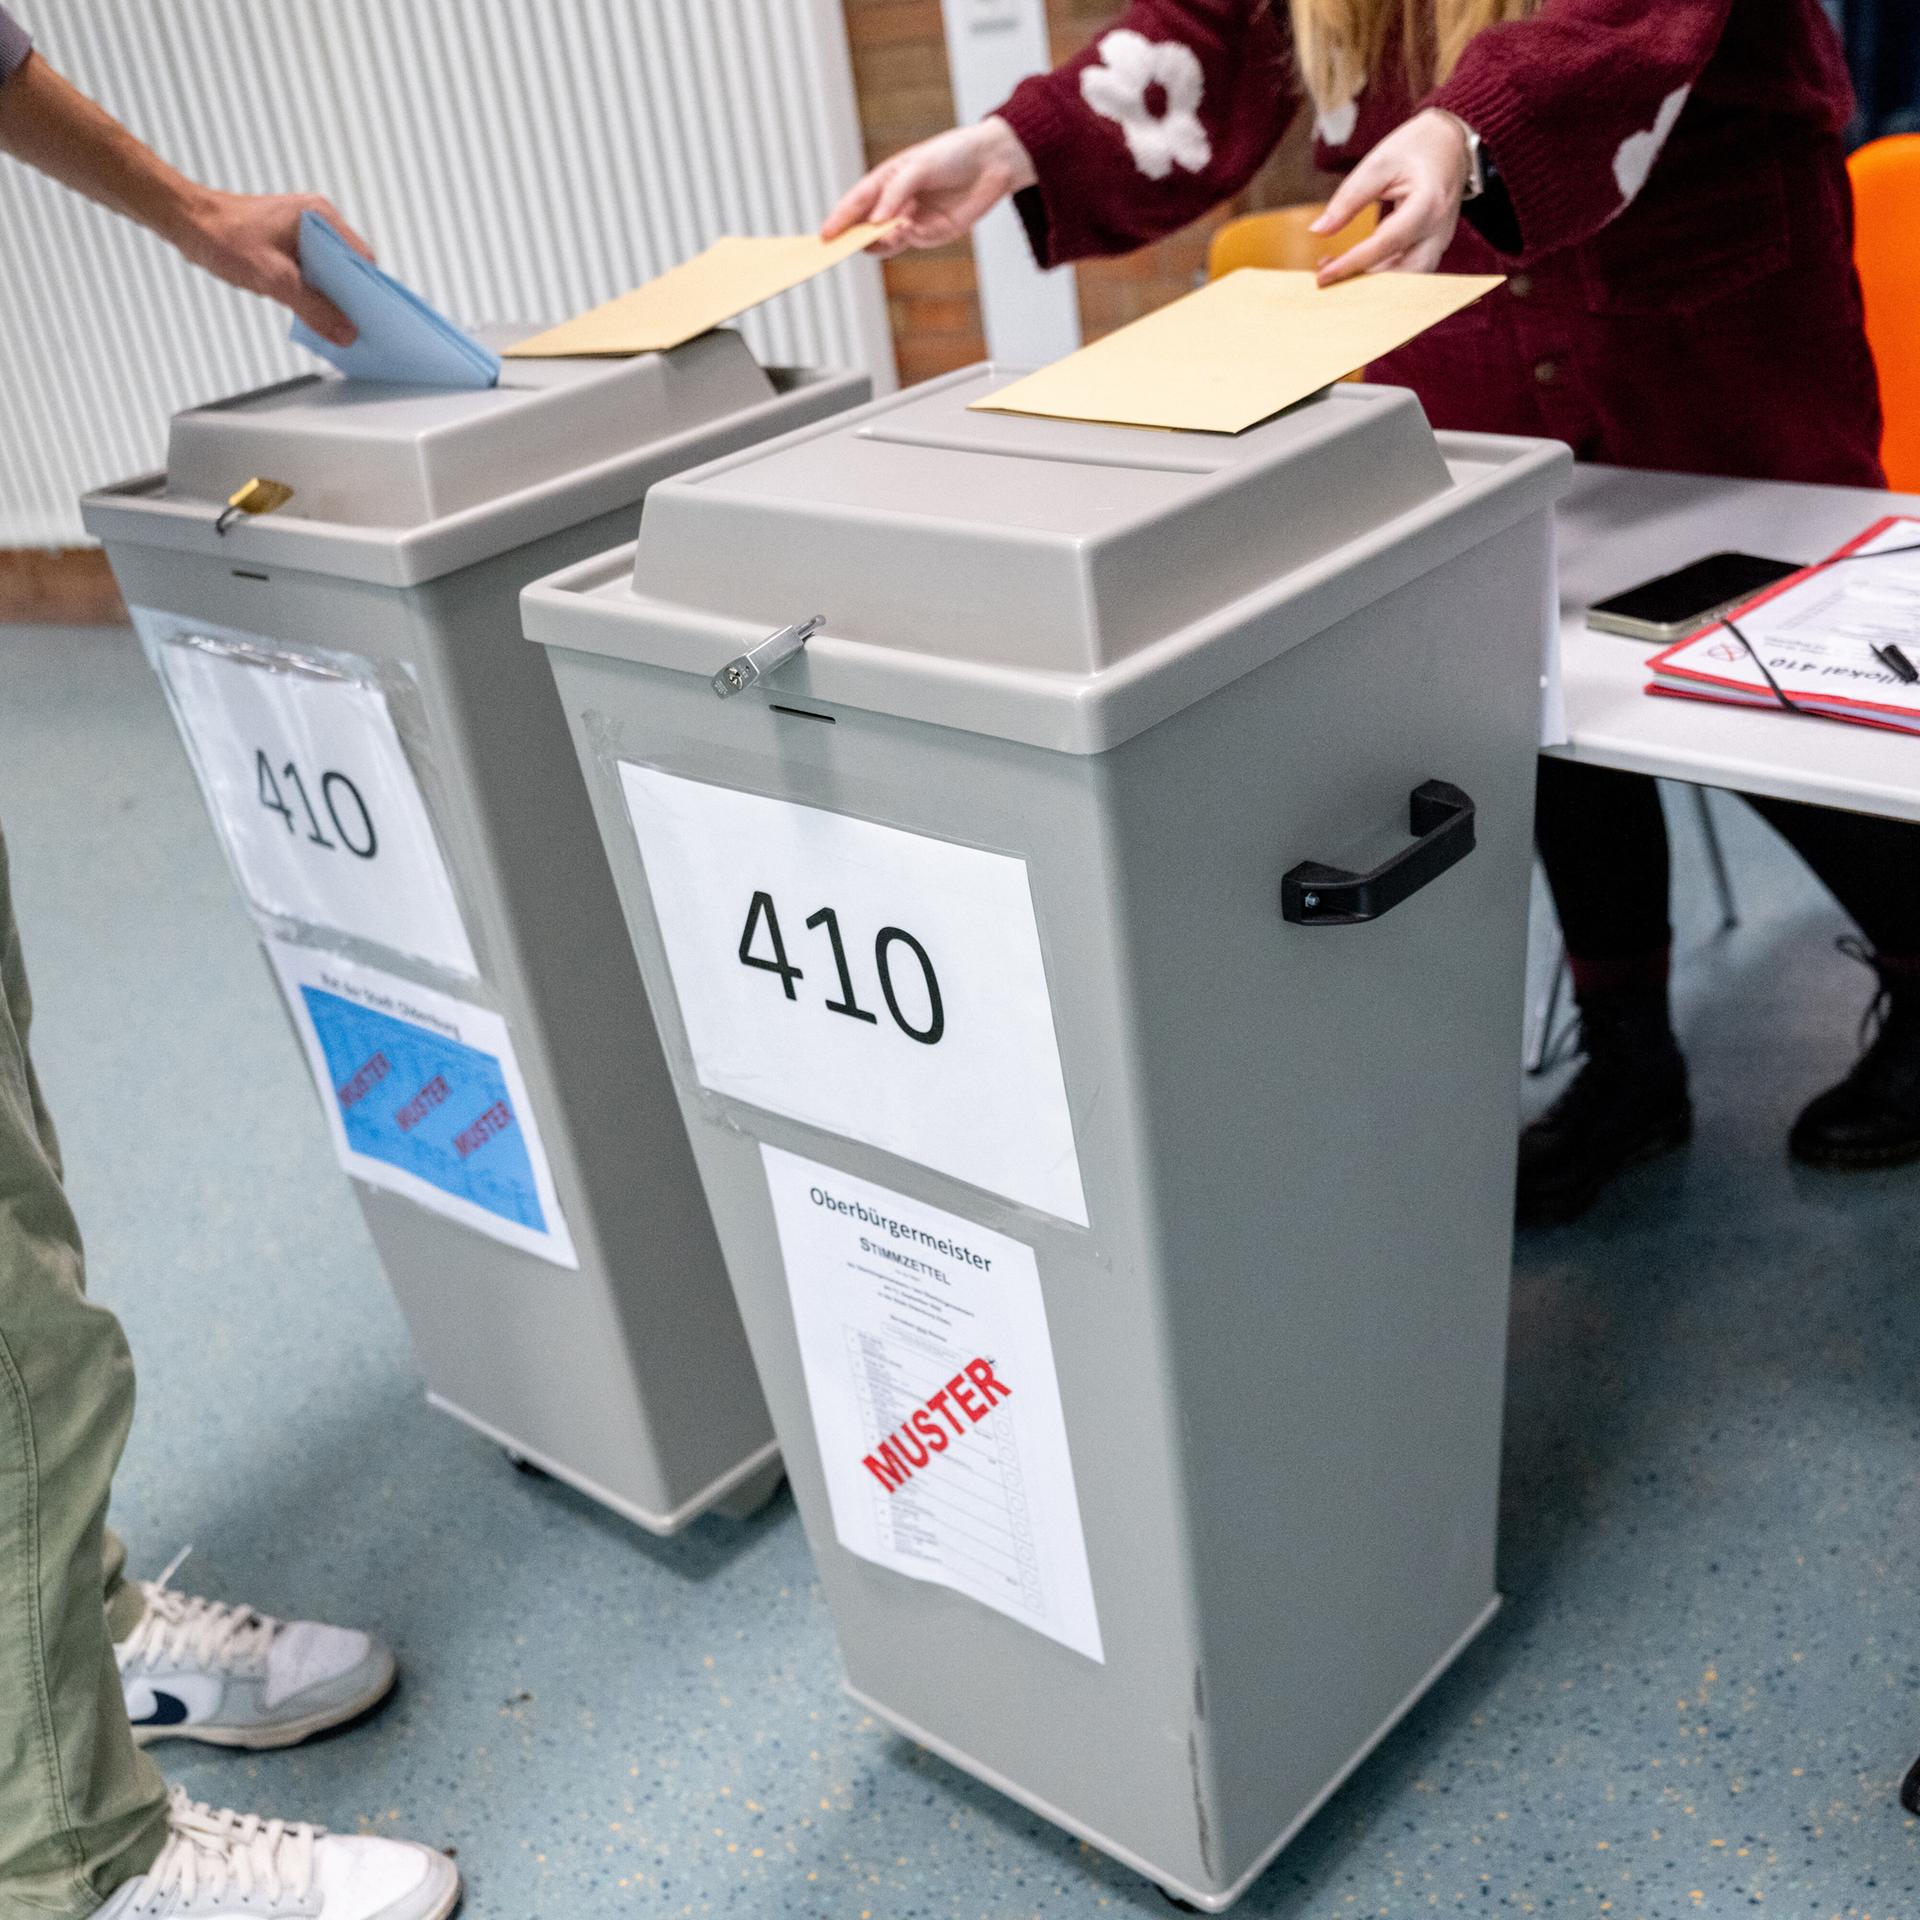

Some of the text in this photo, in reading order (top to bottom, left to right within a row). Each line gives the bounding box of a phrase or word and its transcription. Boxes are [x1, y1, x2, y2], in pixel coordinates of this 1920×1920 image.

[1769, 657, 1817, 672] 410
[256, 749, 377, 859] 410
[738, 890, 945, 1045] 410
[809, 1186, 993, 1273] Oberbürgermeister
[863, 1357, 1012, 1494] MUSTER
